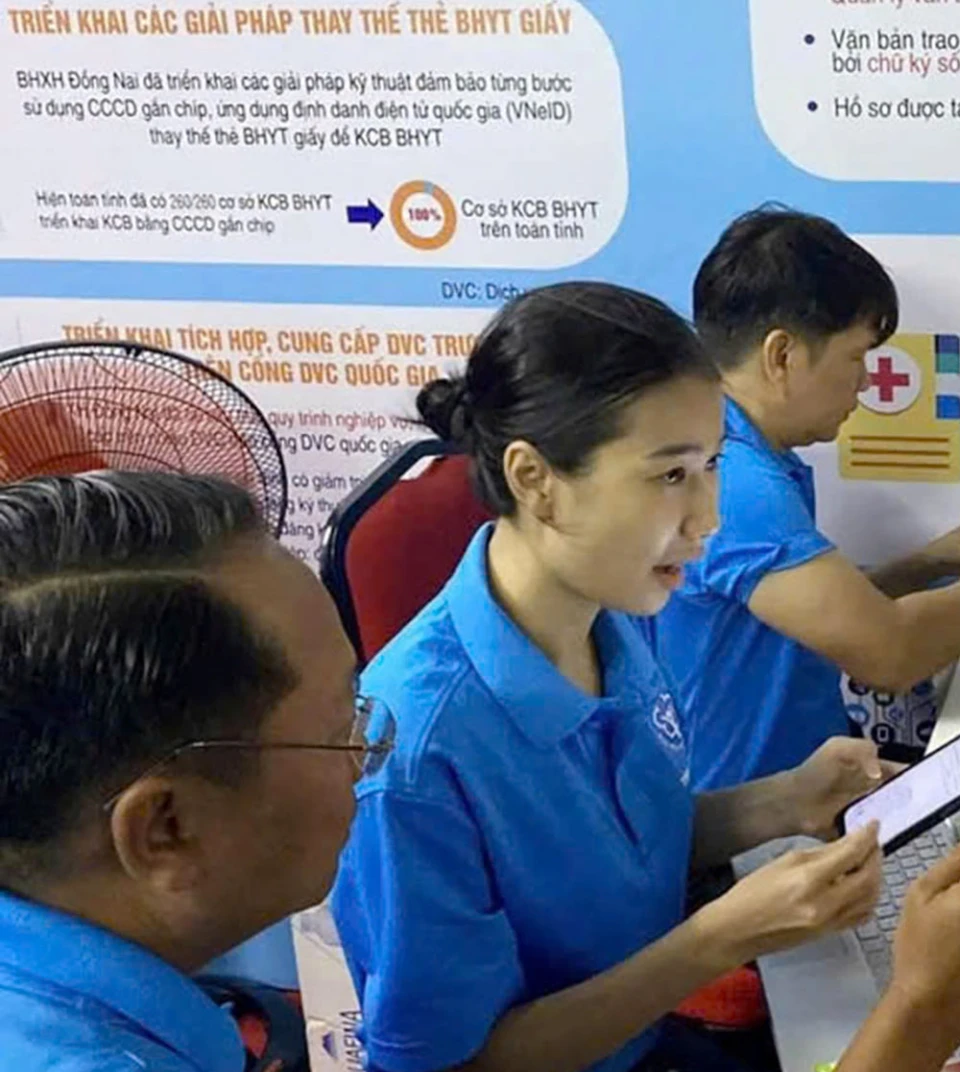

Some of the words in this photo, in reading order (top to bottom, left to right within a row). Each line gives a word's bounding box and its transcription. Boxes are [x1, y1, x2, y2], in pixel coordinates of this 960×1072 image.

[78, 10, 129, 35] KHAI
[135, 3, 178, 35] CÁC
[185, 3, 229, 35] GIẢI
[235, 3, 293, 35] PHÁP
[301, 9, 352, 35] THAY
[360, 2, 401, 35] THẾ
[456, 9, 512, 35] BHYT
[519, 2, 572, 35] GIẤY
[831, 27, 871, 50] Văn
[877, 27, 915, 50] bản
[921, 31, 960, 50] trao
[867, 52, 903, 74] chữ
[909, 52, 931, 77] ký
[17, 70, 64, 89] BHXH
[113, 71, 140, 90] Nai
[205, 71, 238, 91] khai
[241, 71, 270, 91] các
[273, 71, 301, 95] giải
[305, 72, 345, 98] pháp
[46, 100, 85, 121] dụng
[88, 100, 138, 118] CCCD
[250, 100, 290, 122] dụng
[331, 101, 371, 119] danh
[375, 101, 409, 121] điện
[433, 101, 473, 123] quốc
[477, 103, 501, 124] gia
[506, 100, 573, 125] (VNeID)
[868, 100, 892, 119] sơ
[897, 98, 945, 120] được
[150, 128, 182, 149] thay
[186, 125, 211, 146] thế
[243, 127, 289, 147] BHYT
[355, 129, 392, 147] KCB
[396, 129, 443, 148] BHYT
[258, 193, 290, 211] KCB
[292, 193, 333, 212] BHYT
[461, 198, 486, 218] Cơ
[511, 199, 549, 219] KCB
[552, 200, 600, 219] BHYT
[72, 214, 100, 231] khai
[102, 214, 133, 231] KCB
[172, 215, 215, 232] CCCD
[247, 216, 275, 237] chip
[408, 207, 442, 222] 100%
[480, 221, 511, 239] trên
[441, 281, 482, 300] DVC:
[177, 323, 222, 351] TÍCH
[278, 331, 333, 353] CUNG
[339, 325, 381, 355] CẤP
[387, 333, 426, 356] DVC
[300, 363, 339, 385] DVC
[345, 357, 400, 387] QUỐC
[268, 411, 294, 428] quy
[299, 411, 333, 427] trình
[335, 411, 386, 431] nghiệp
[301, 434, 335, 451] DVC
[339, 434, 377, 455] quốc
